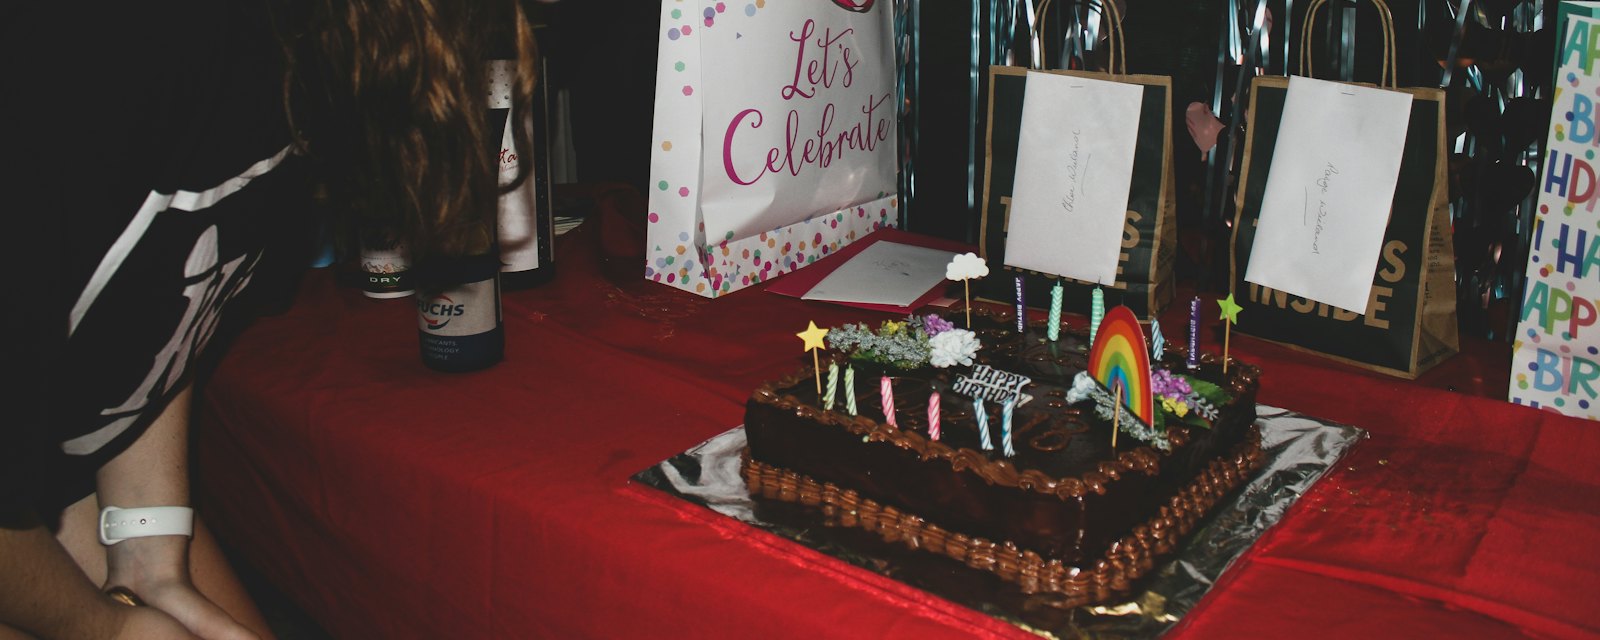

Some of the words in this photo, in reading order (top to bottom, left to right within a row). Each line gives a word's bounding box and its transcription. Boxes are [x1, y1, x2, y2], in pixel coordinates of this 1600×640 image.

[781, 19, 858, 100] Let's
[722, 93, 891, 185] Celebrate
[370, 276, 401, 284] DRY
[972, 364, 1028, 391] HAPPY
